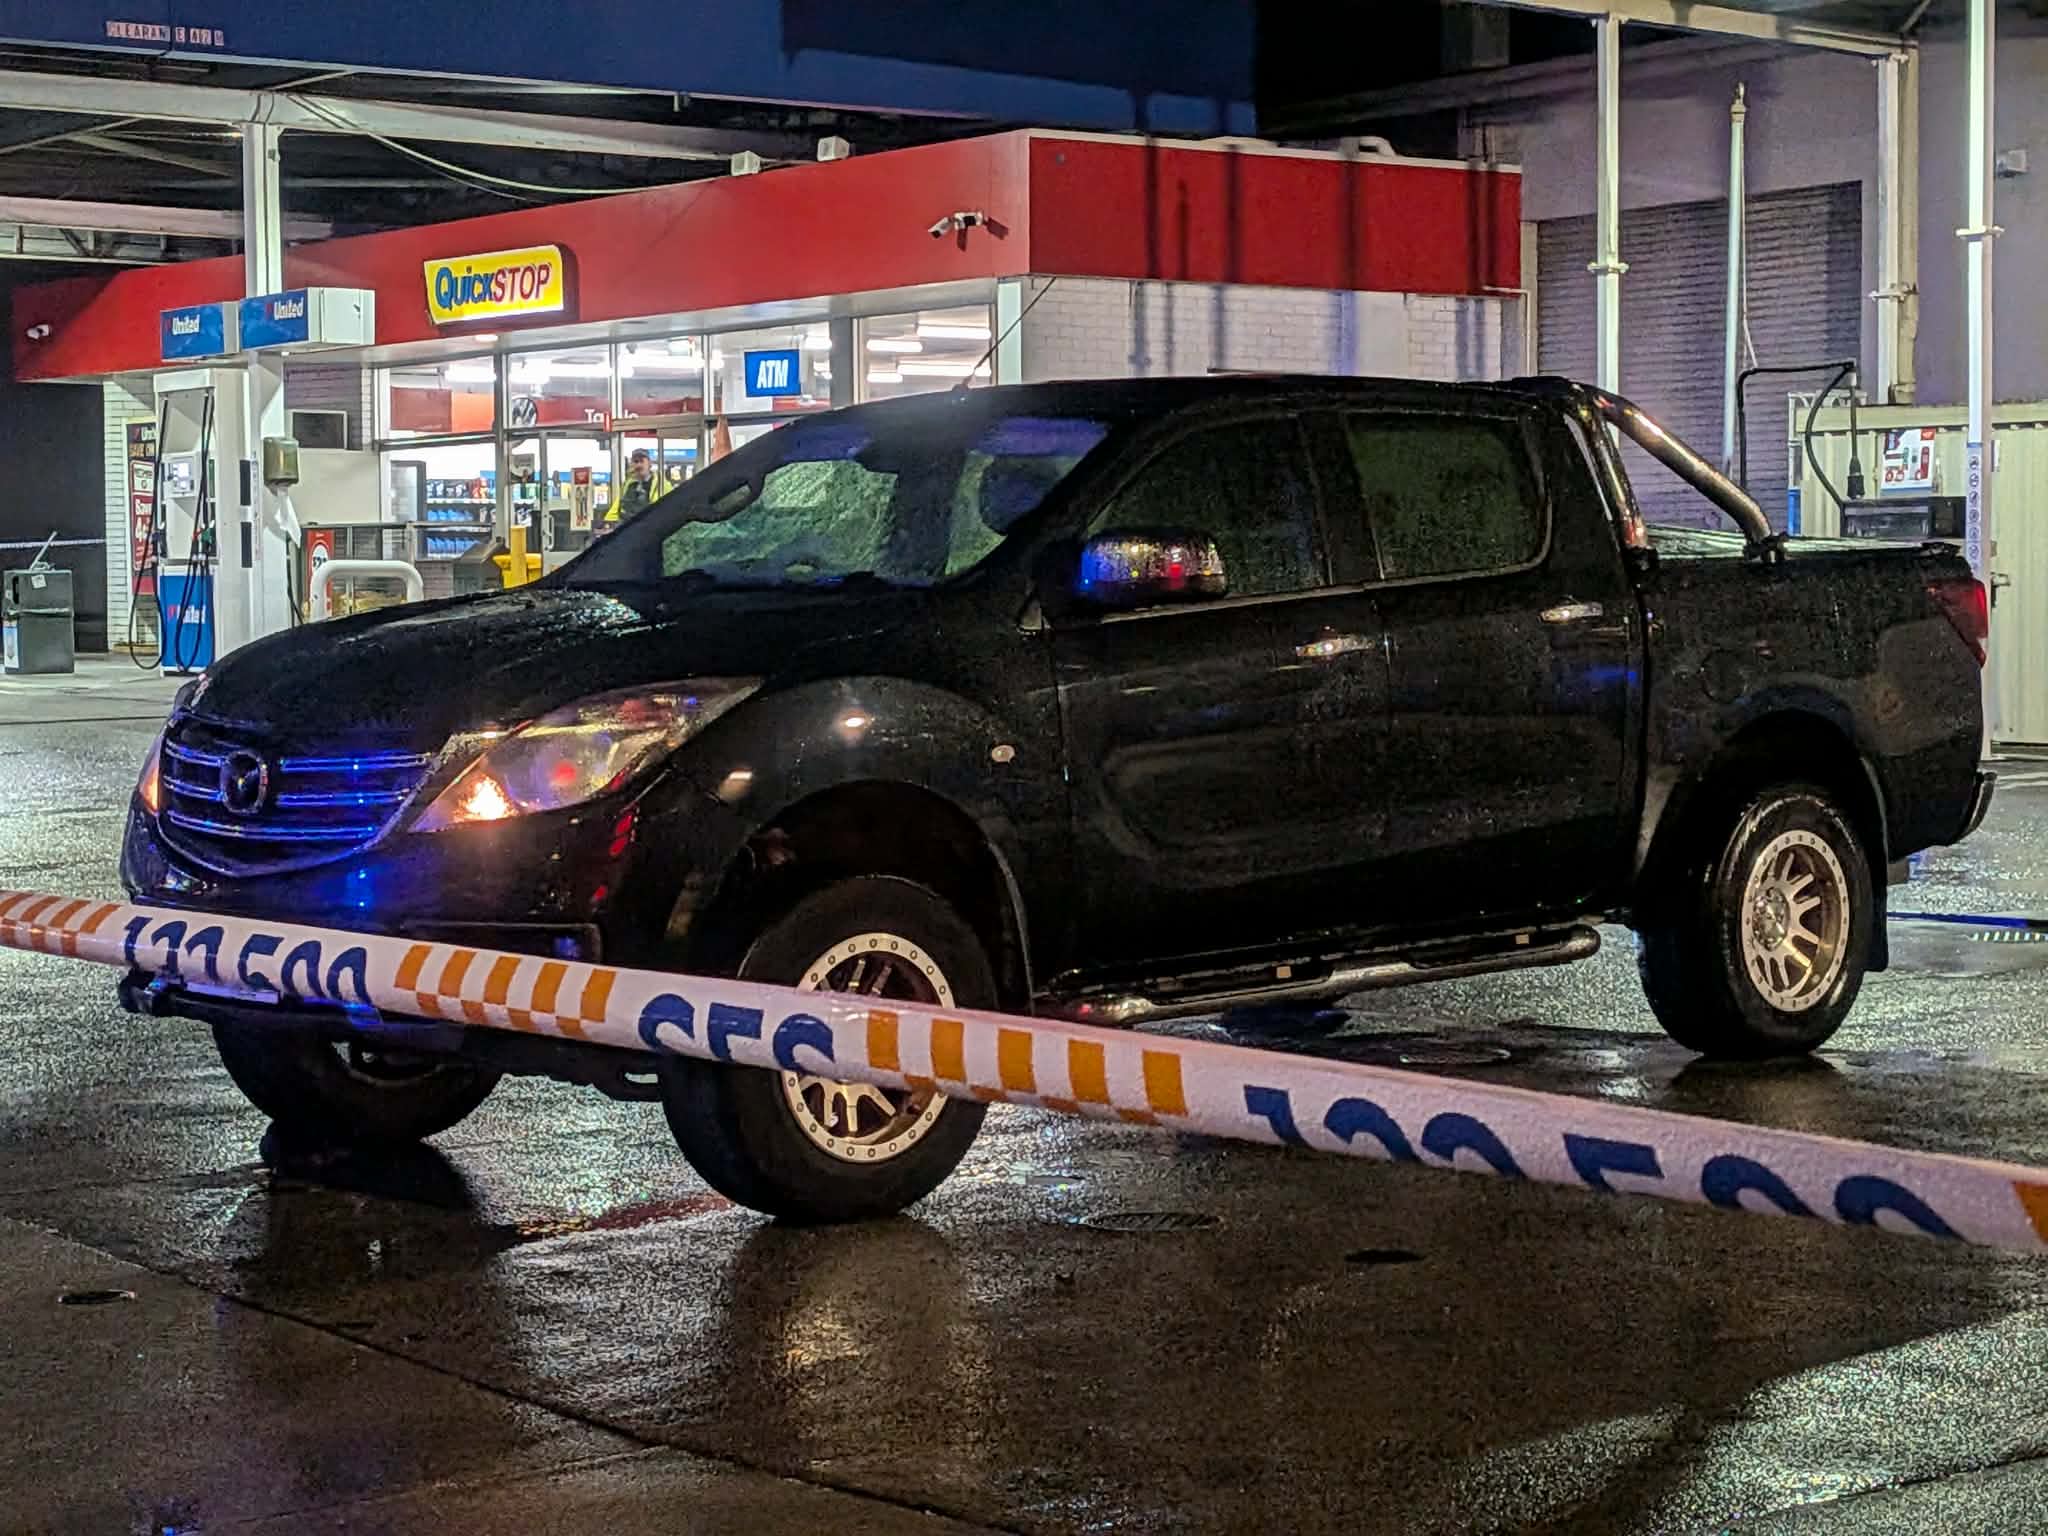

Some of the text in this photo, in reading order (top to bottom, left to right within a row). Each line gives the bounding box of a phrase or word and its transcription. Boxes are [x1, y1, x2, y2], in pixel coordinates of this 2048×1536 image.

[273, 299, 304, 320] United
[172, 315, 200, 335] United
[757, 359, 789, 389] ATM
